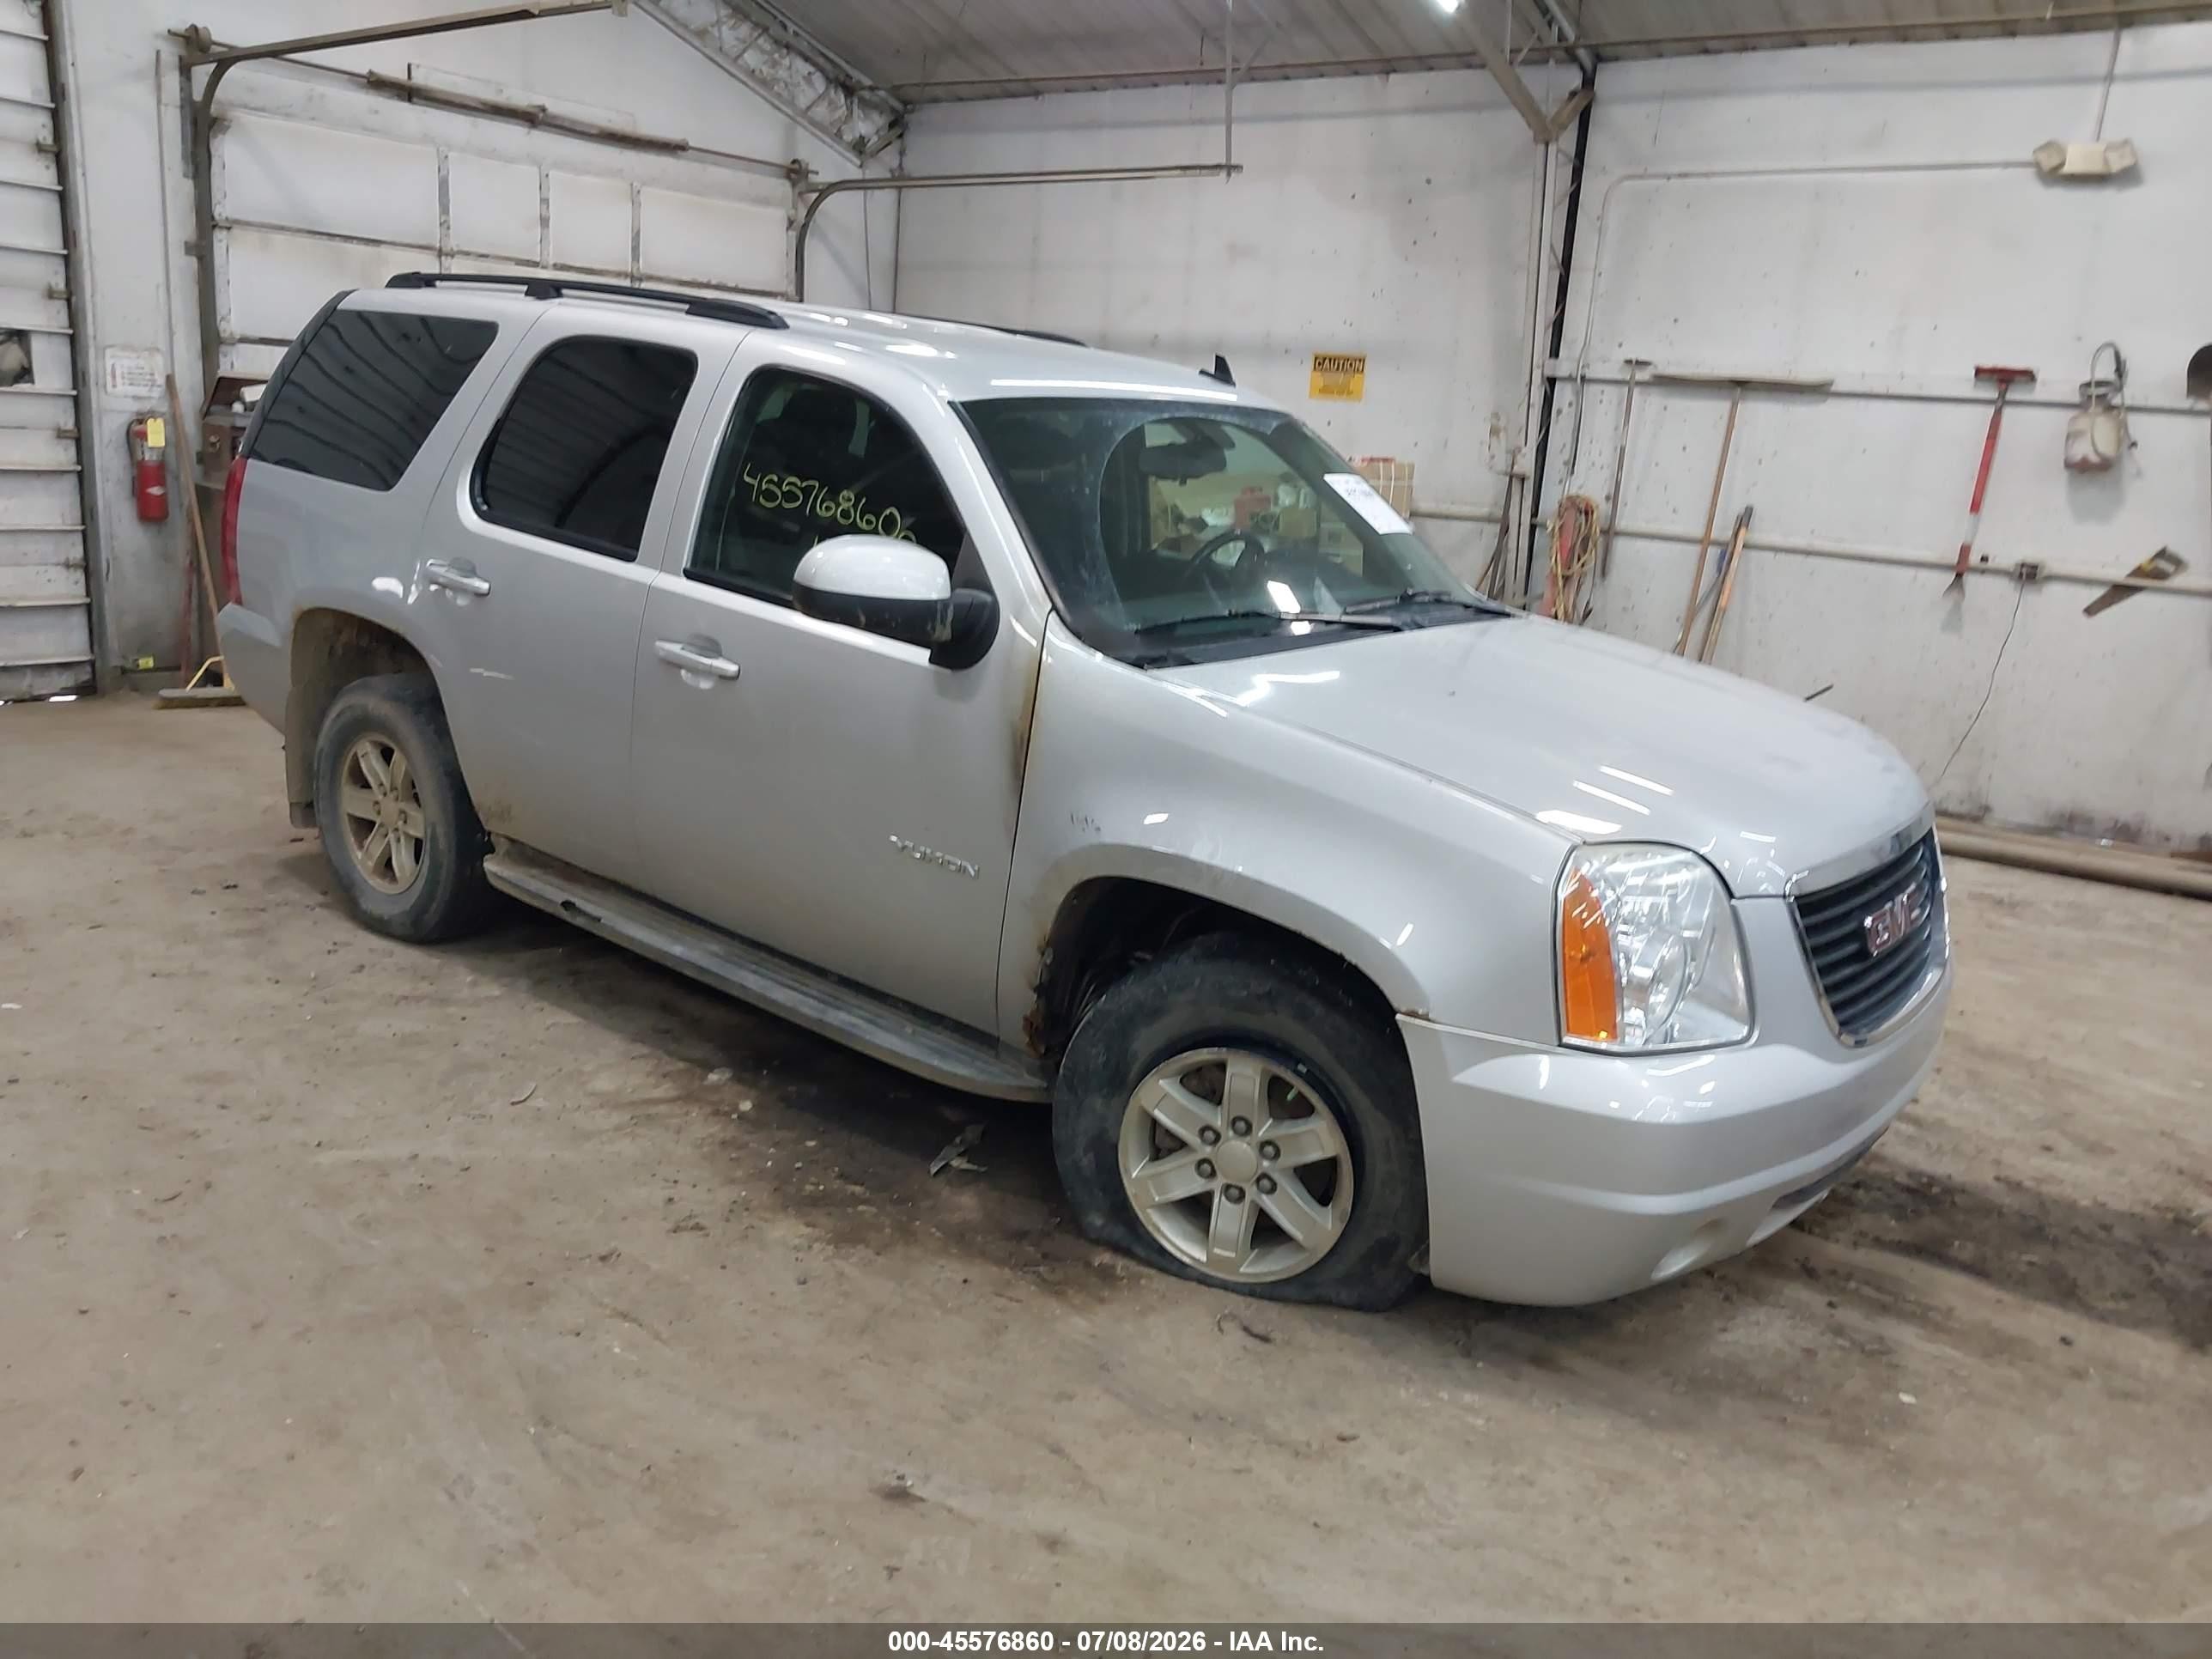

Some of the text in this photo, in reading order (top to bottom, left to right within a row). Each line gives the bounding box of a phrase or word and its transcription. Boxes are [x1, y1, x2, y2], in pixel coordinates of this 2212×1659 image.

[1315, 357, 1364, 371] CAUTION
[890, 835, 980, 879] YUKON
[1864, 883, 1922, 957] GMC
